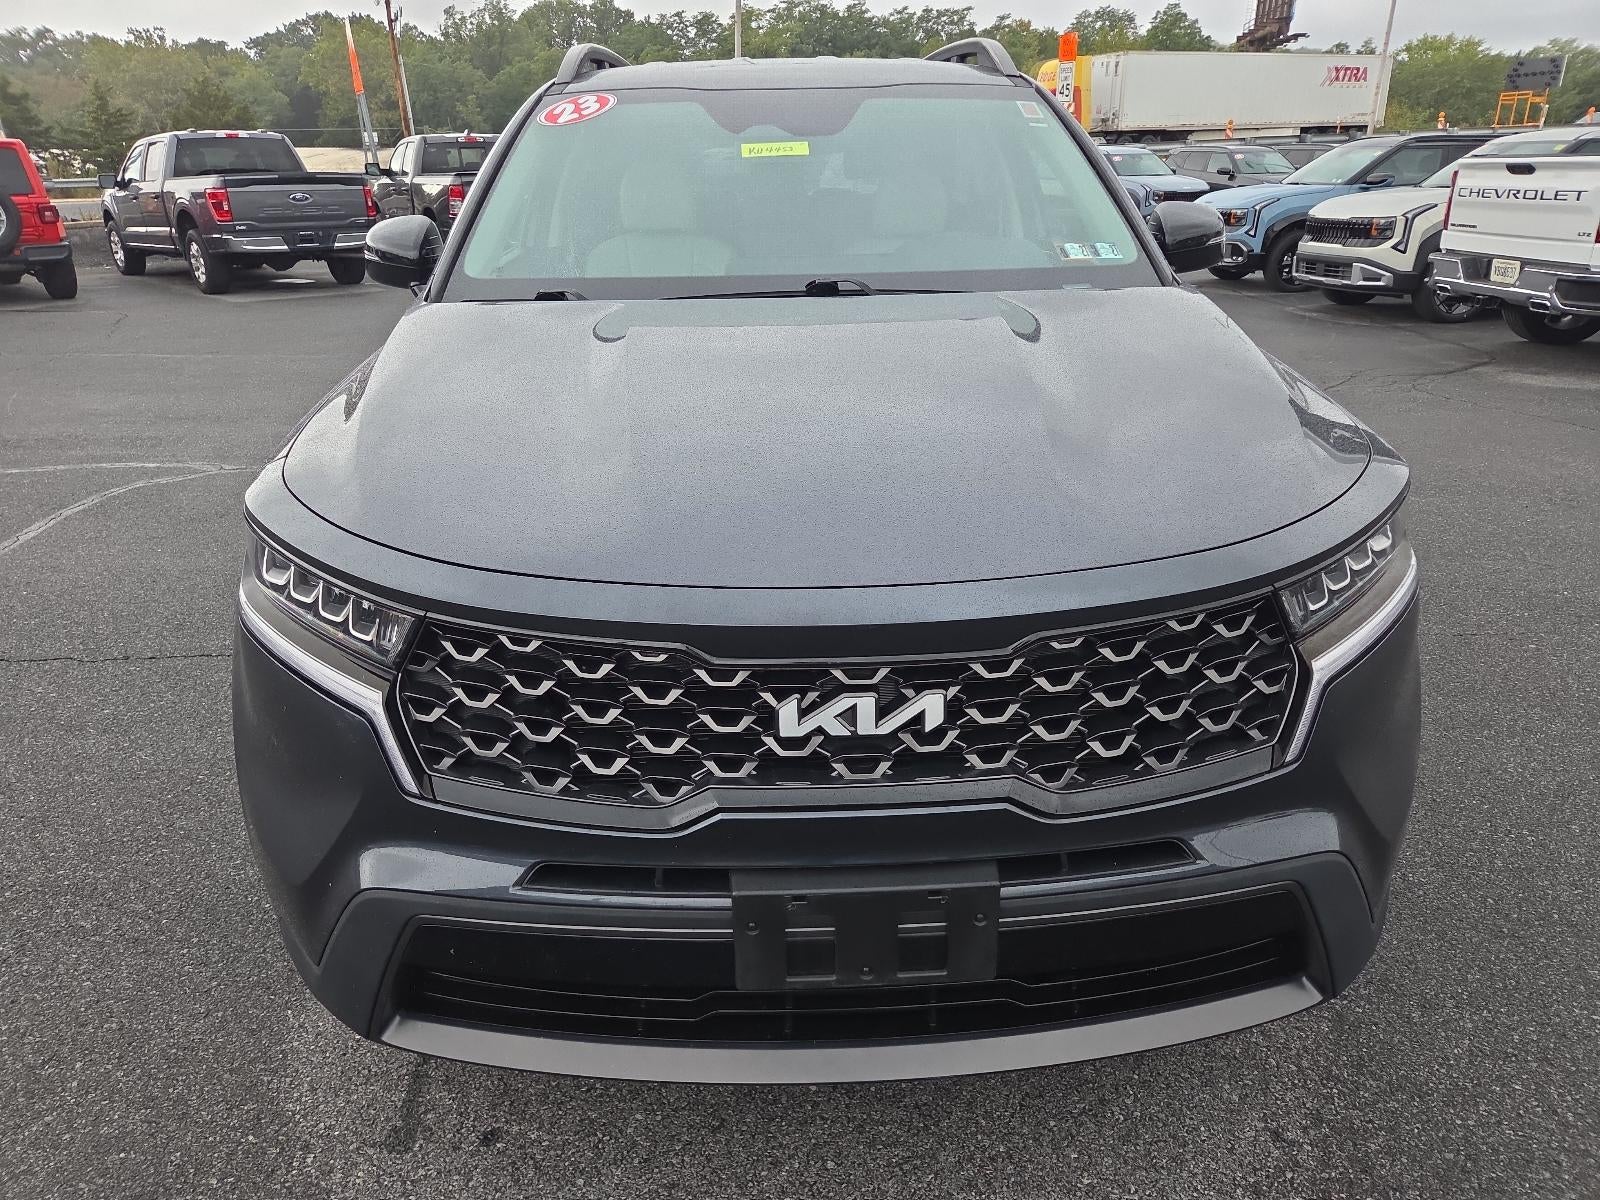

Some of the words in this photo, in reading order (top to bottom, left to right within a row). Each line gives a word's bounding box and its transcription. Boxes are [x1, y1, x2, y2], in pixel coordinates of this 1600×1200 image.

[1059, 83, 1071, 98] 45
[552, 95, 602, 124] 23
[1457, 187, 1589, 202] CHEVROLET
[775, 689, 947, 738] KIA
